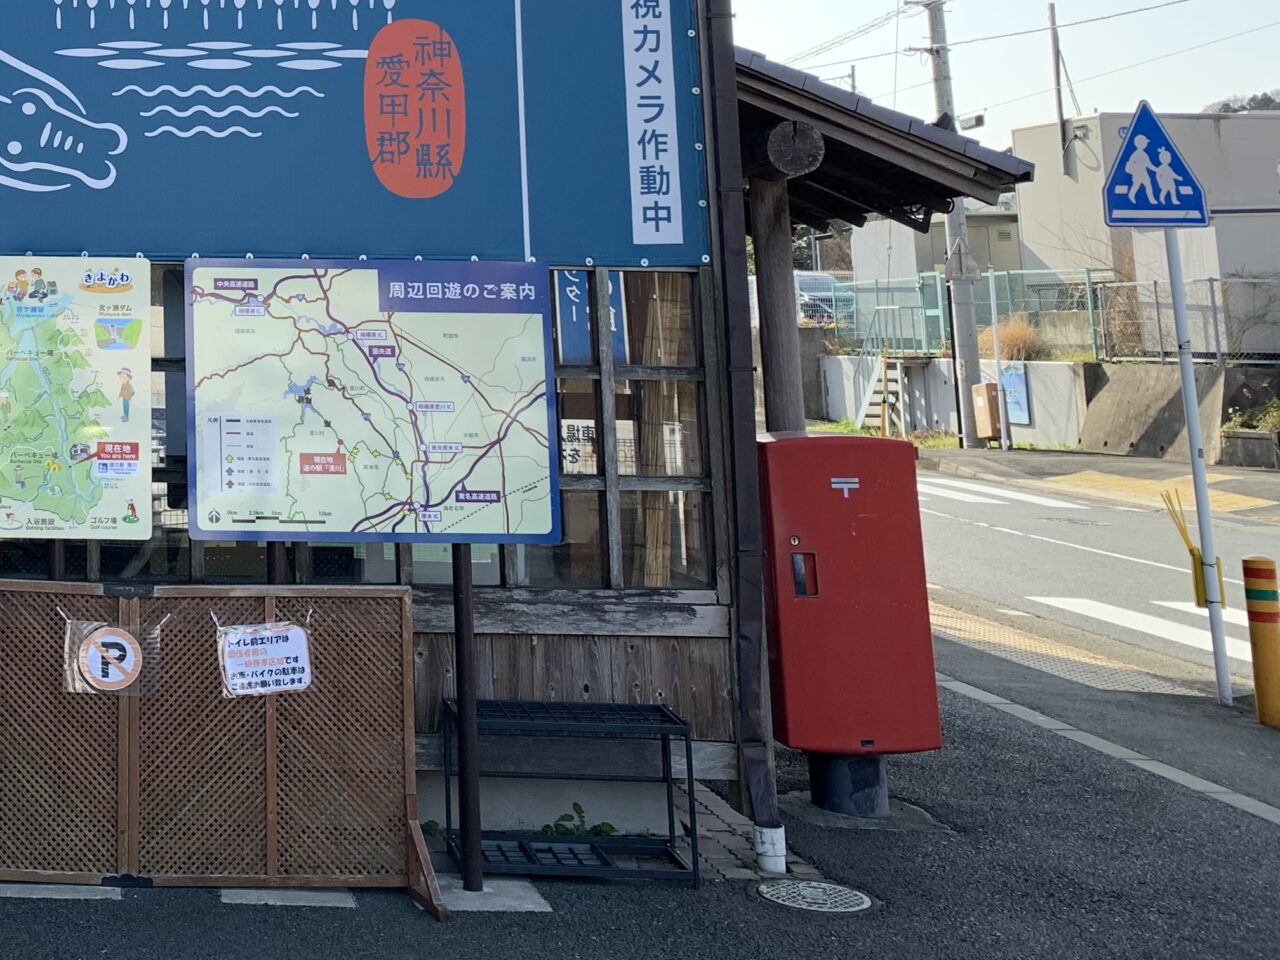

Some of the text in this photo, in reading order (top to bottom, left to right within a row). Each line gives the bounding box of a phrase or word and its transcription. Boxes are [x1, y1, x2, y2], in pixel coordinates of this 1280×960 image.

[372, 53, 410, 167] 愛甲郡
[84, 271, 130, 287] きよかわ
[389, 282, 536, 300] 周辺回遊のご案内
[228, 635, 290, 648] トイレ前エリアは
